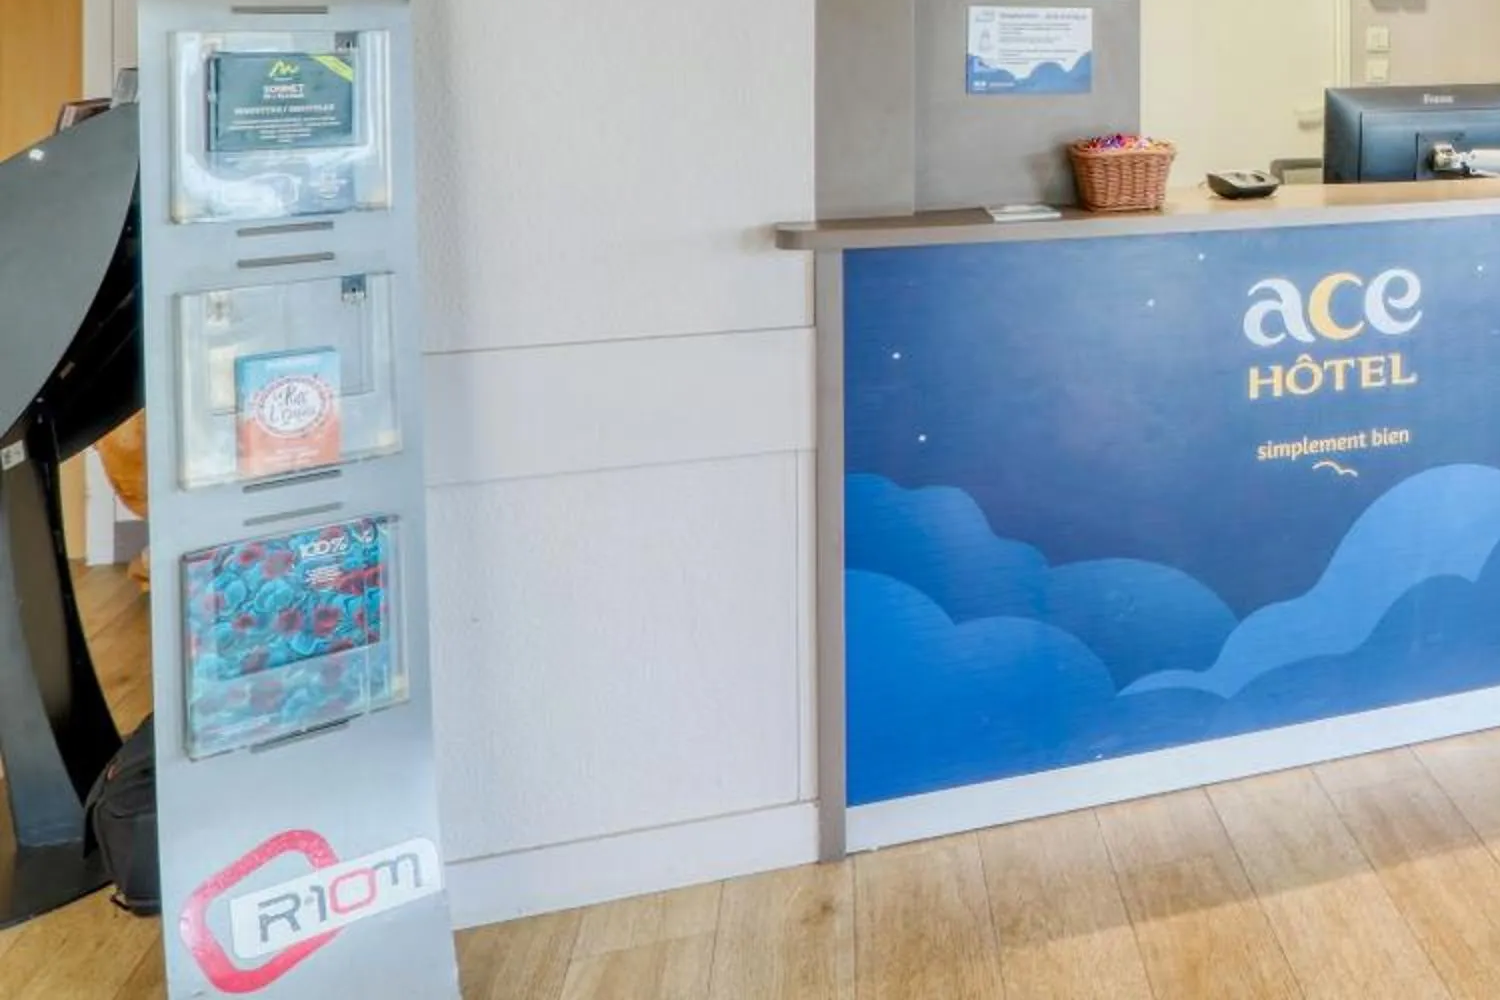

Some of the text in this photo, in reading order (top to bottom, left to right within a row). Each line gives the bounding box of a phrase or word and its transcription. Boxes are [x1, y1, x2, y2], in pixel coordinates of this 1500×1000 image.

[1243, 268, 1423, 347] ace
[1248, 353, 1418, 400] HÔTEL
[1257, 427, 1410, 461] simplement bien
